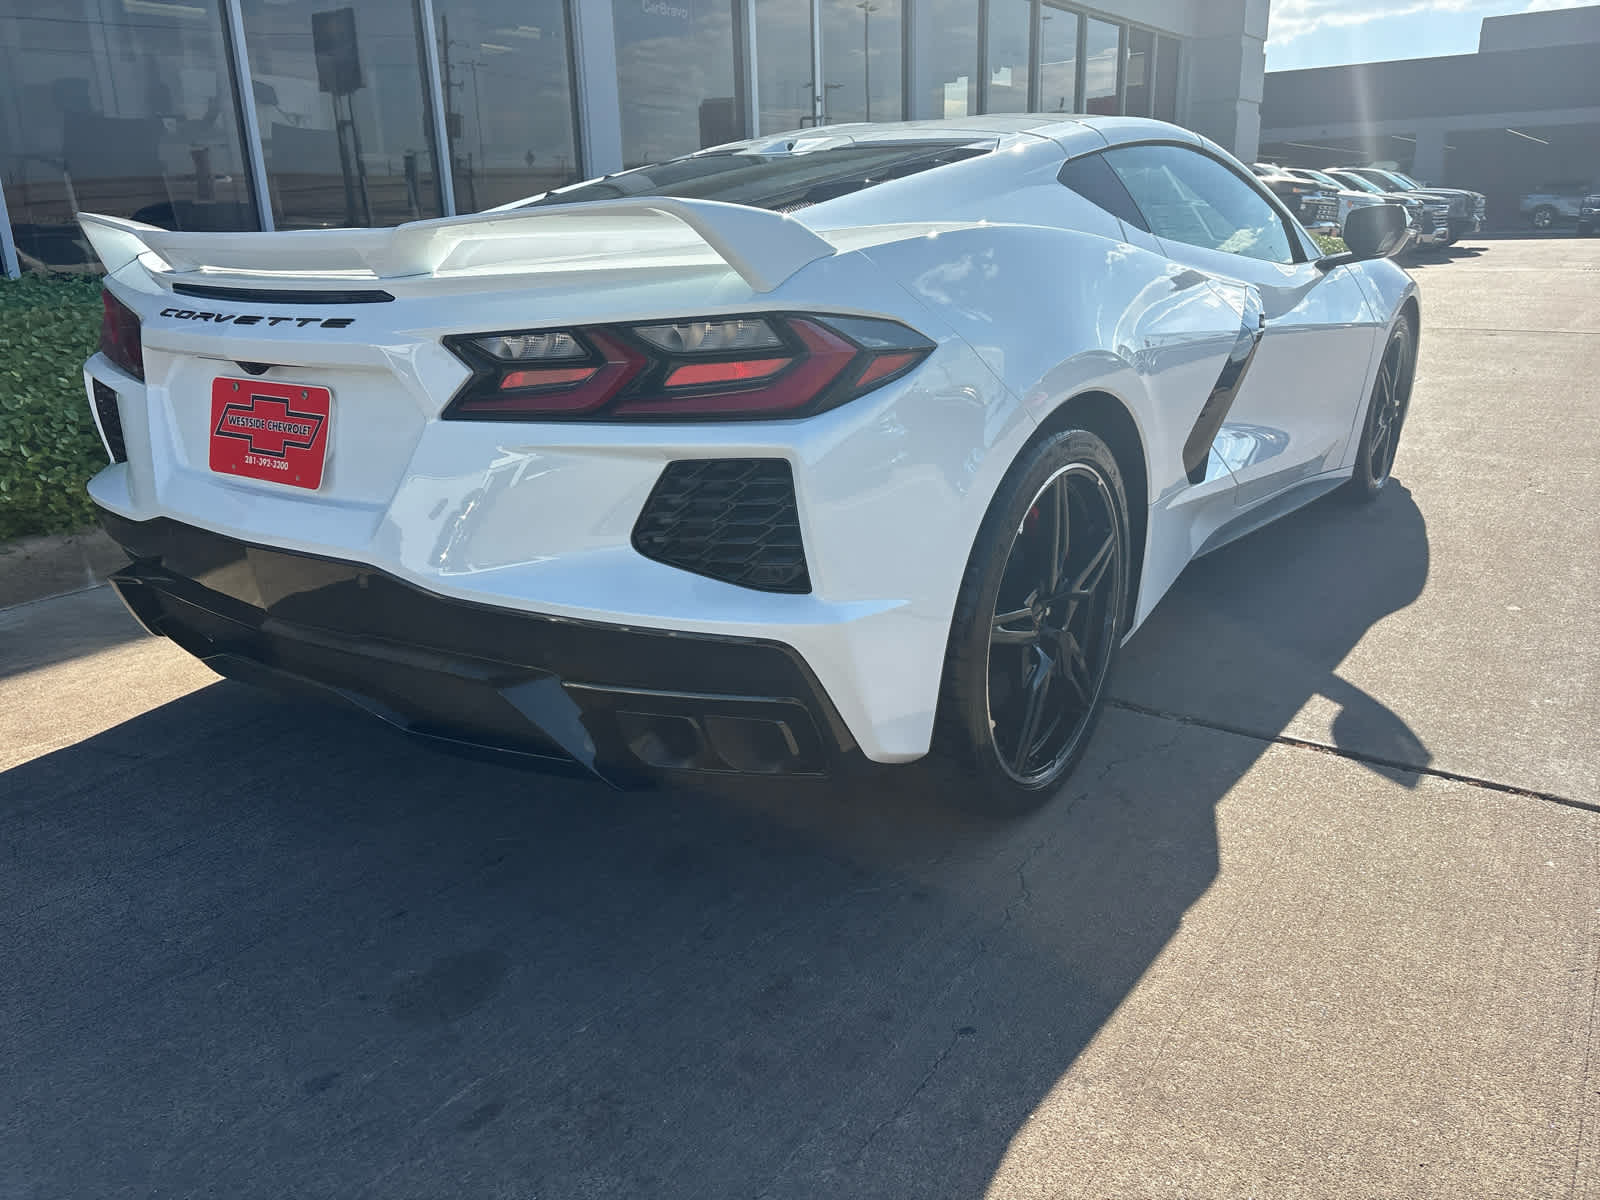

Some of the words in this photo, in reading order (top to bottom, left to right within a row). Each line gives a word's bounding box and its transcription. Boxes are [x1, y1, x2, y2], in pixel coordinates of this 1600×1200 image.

[160, 308, 355, 328] CORVETTE
[228, 415, 265, 429] WESTSIDE
[267, 420, 311, 435] CHEVROLET
[245, 455, 289, 470] 281-392-3200
